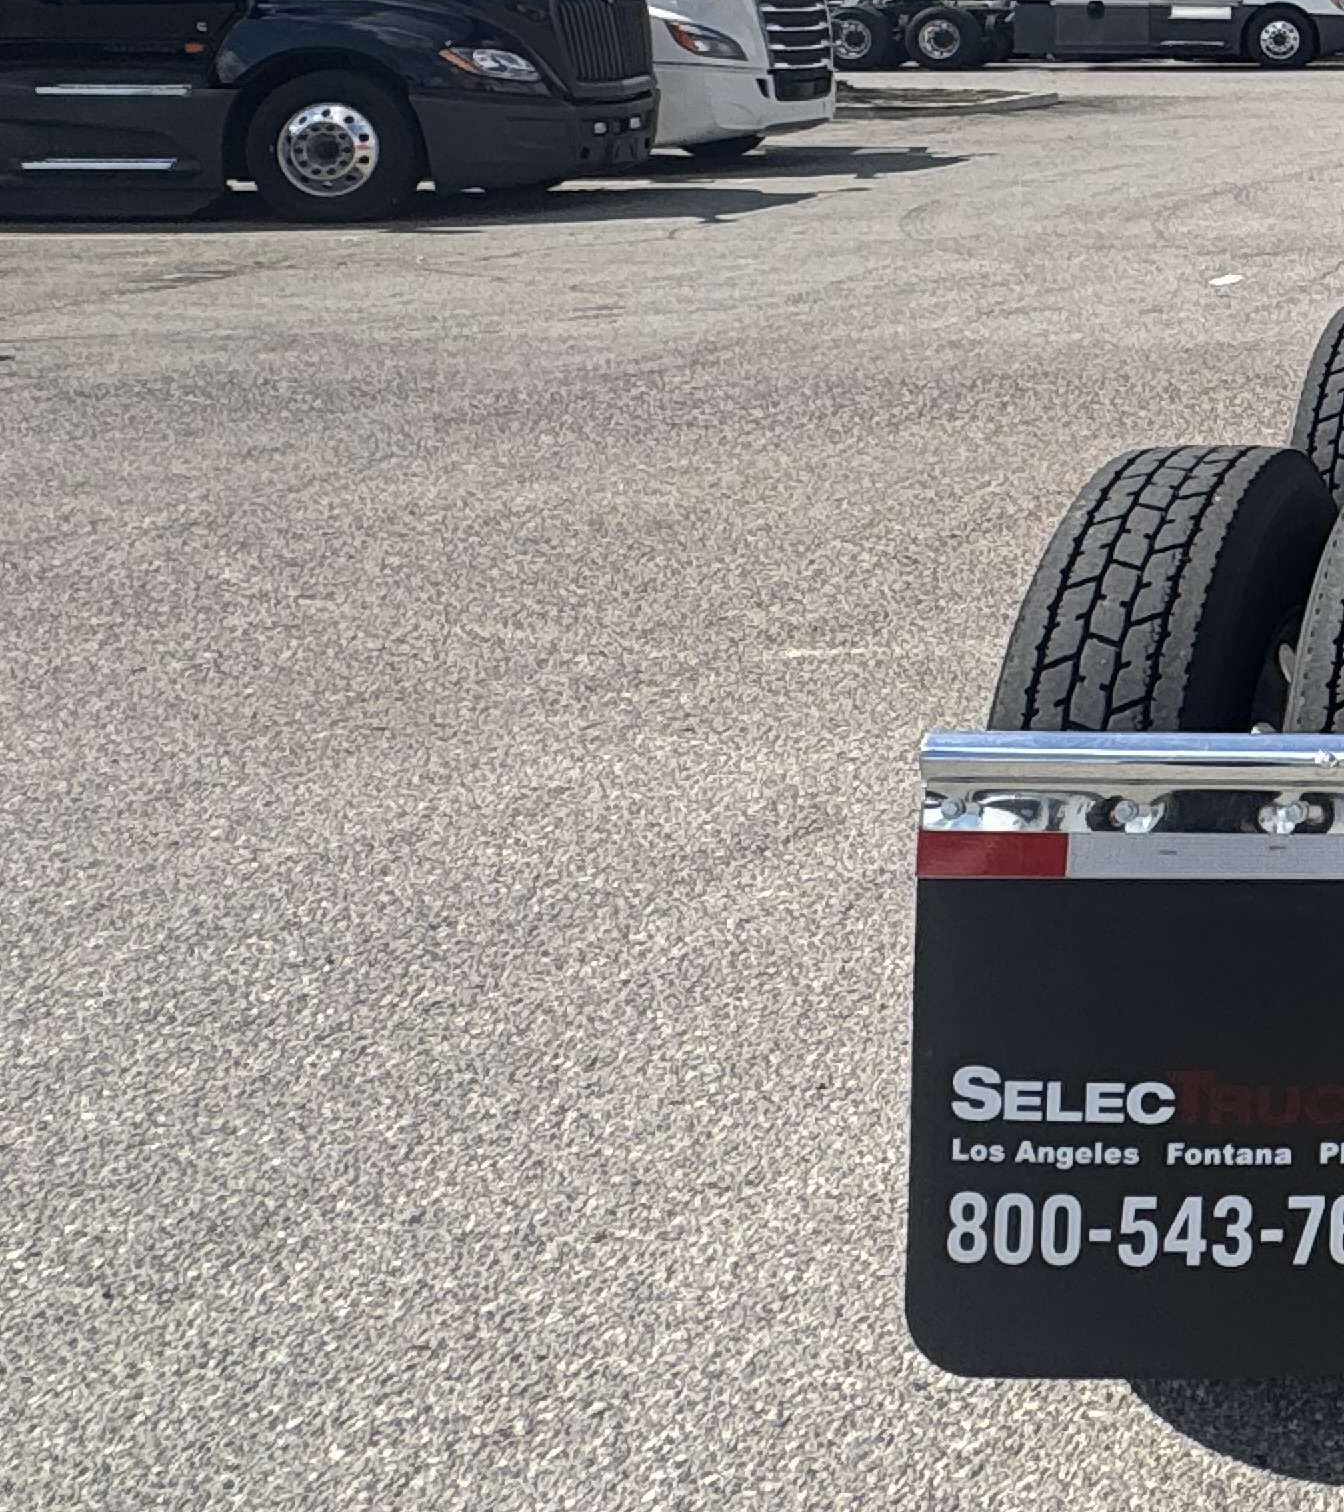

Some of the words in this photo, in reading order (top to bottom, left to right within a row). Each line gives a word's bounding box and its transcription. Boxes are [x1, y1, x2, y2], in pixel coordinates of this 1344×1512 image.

[951, 1137, 1005, 1164] Los
[1014, 1140, 1140, 1170] Angeles
[1166, 1142, 1293, 1167] Fontana
